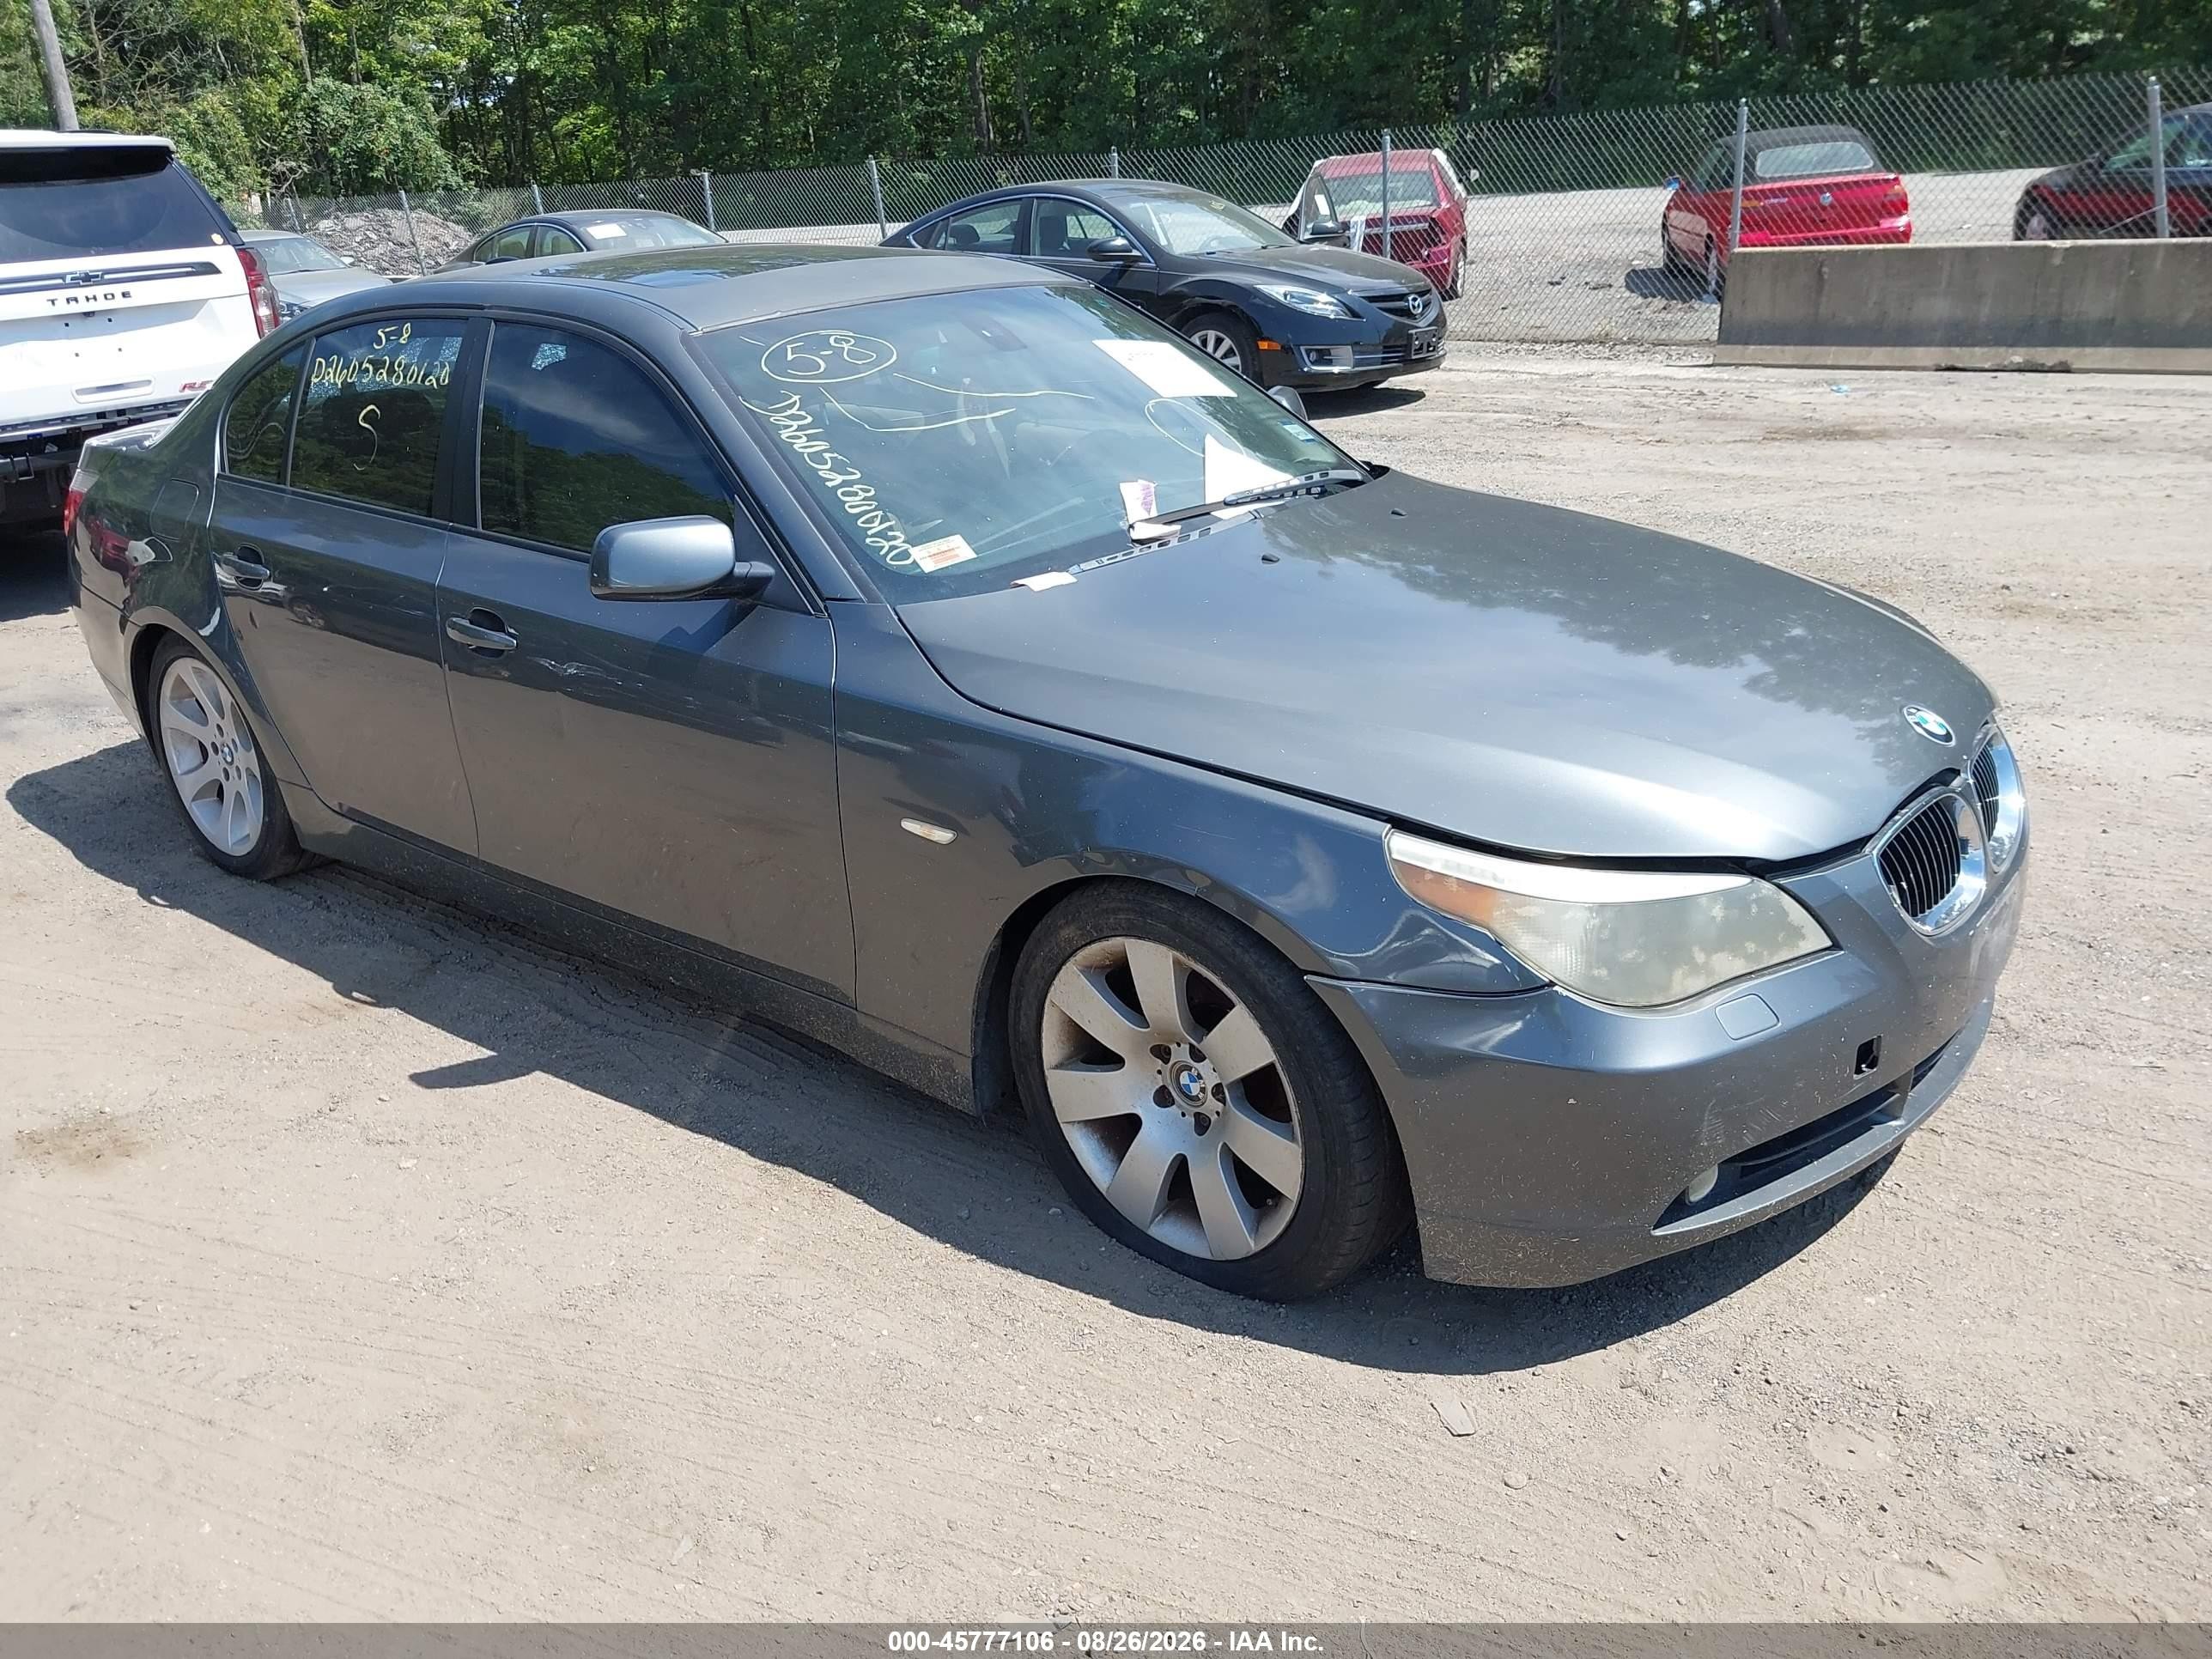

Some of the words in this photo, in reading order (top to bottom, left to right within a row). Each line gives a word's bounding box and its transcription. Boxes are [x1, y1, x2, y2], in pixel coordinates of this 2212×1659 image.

[46, 291, 132, 307] TAHOE
[373, 322, 412, 349] 5-8
[786, 335, 877, 376] 5-8
